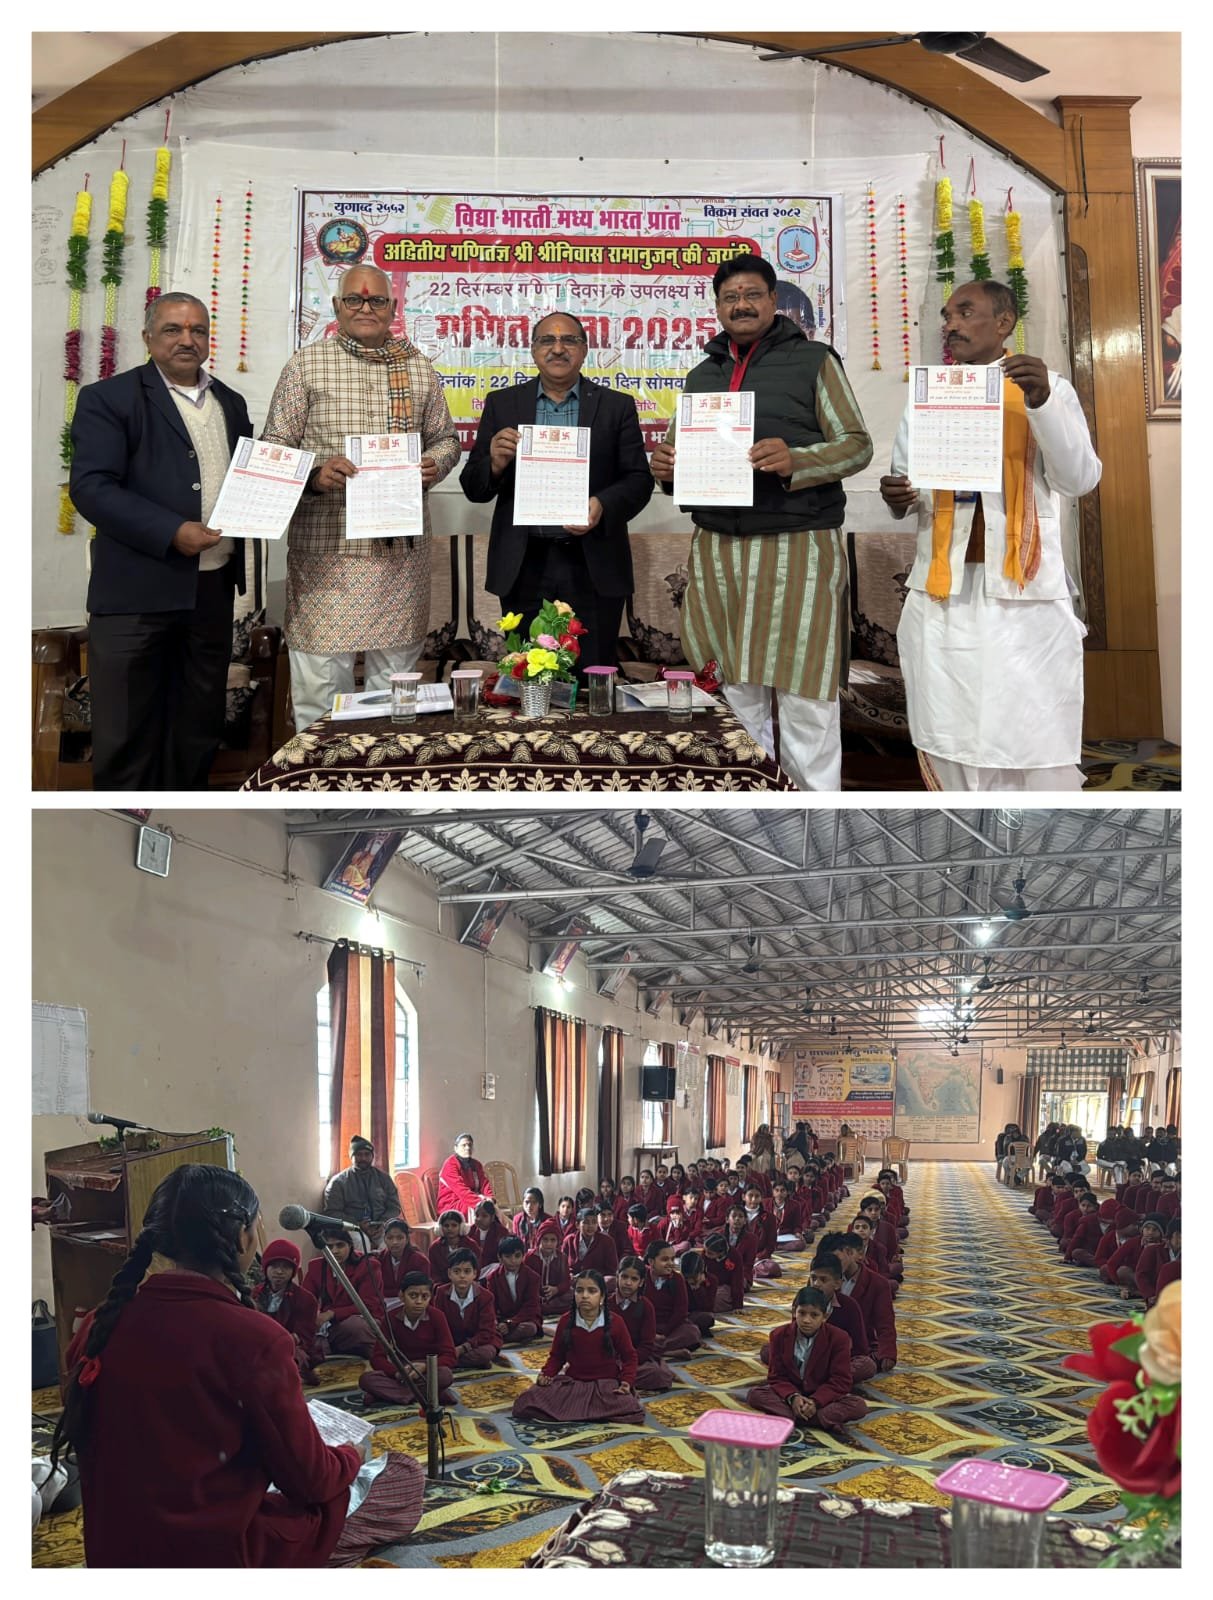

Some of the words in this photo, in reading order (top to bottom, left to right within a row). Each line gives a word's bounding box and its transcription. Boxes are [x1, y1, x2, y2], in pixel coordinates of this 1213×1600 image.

[334, 202, 372, 216] युगाब्द
[455, 203, 496, 228] विद्या
[502, 205, 551, 228] भारती
[557, 209, 593, 228] मध्य
[600, 210, 643, 230] भारत
[648, 204, 682, 230] प्रांत
[704, 204, 737, 218] विक्रम
[740, 204, 769, 218] संवत
[773, 207, 801, 218] २०८२
[384, 240, 447, 262] अद्वितीय
[450, 239, 511, 262] गणितज्ञ
[513, 241, 534, 262] श्री
[536, 241, 604, 264] श्रीनिवास
[607, 246, 682, 270] रामानुजन्
[681, 243, 704, 264] की
[430, 282, 450, 296] 22
[456, 278, 514, 297] दिसम्बर
[566, 279, 606, 298] दिवस
[611, 280, 626, 299] के
[630, 284, 690, 299] उपलक्ष्य
[694, 281, 706, 299] में
[435, 305, 530, 348] गणित
[622, 316, 717, 349] 2025
[490, 376, 509, 387] 22
[616, 373, 641, 389] दिन
[646, 373, 686, 389] सोमव
